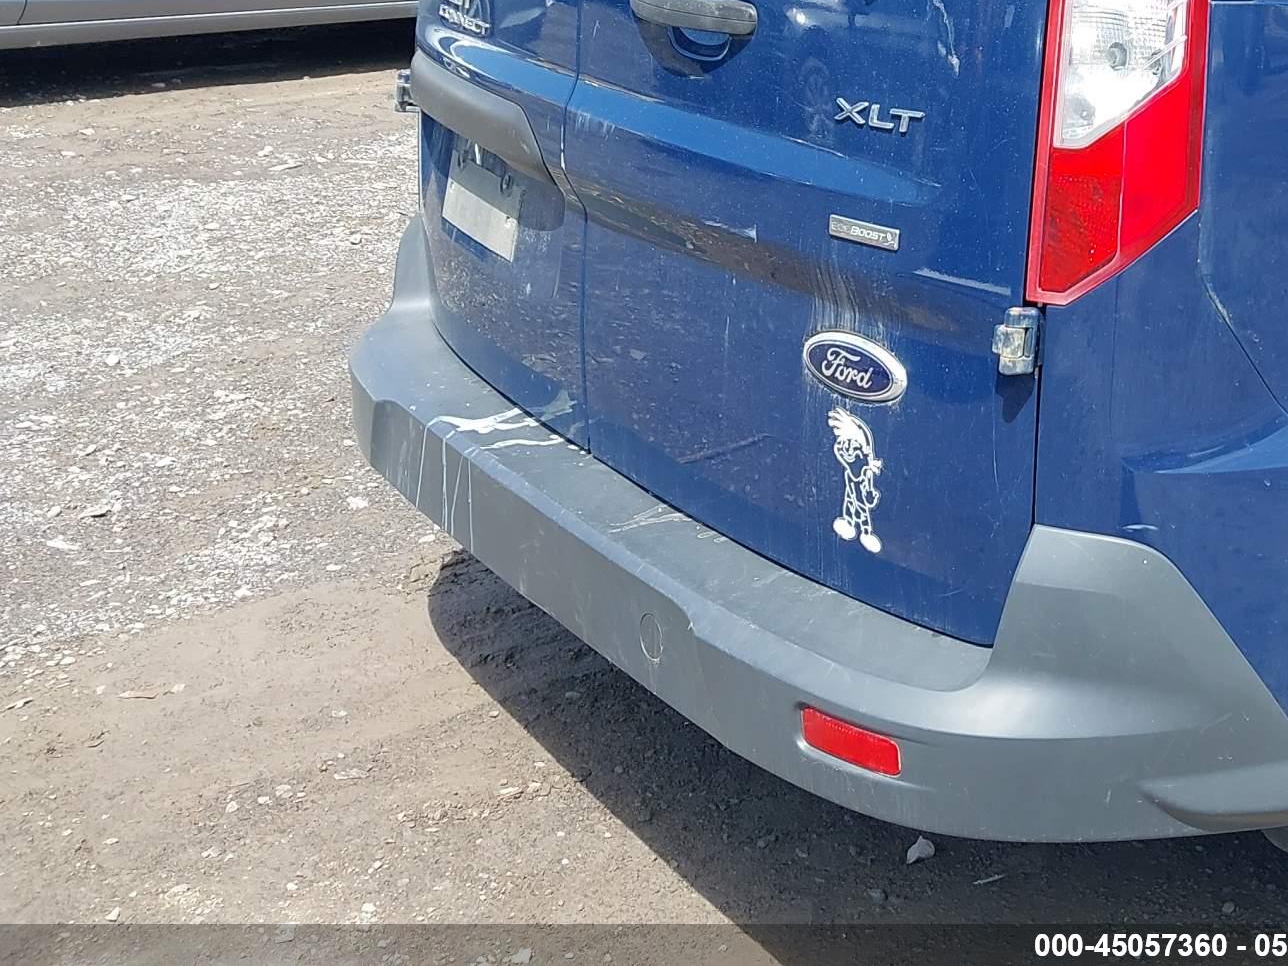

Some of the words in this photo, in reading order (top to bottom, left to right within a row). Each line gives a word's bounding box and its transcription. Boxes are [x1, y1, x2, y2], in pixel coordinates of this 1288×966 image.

[439, 3, 491, 35] CONNECT
[834, 97, 926, 133] XLT
[821, 347, 874, 389] Ford
